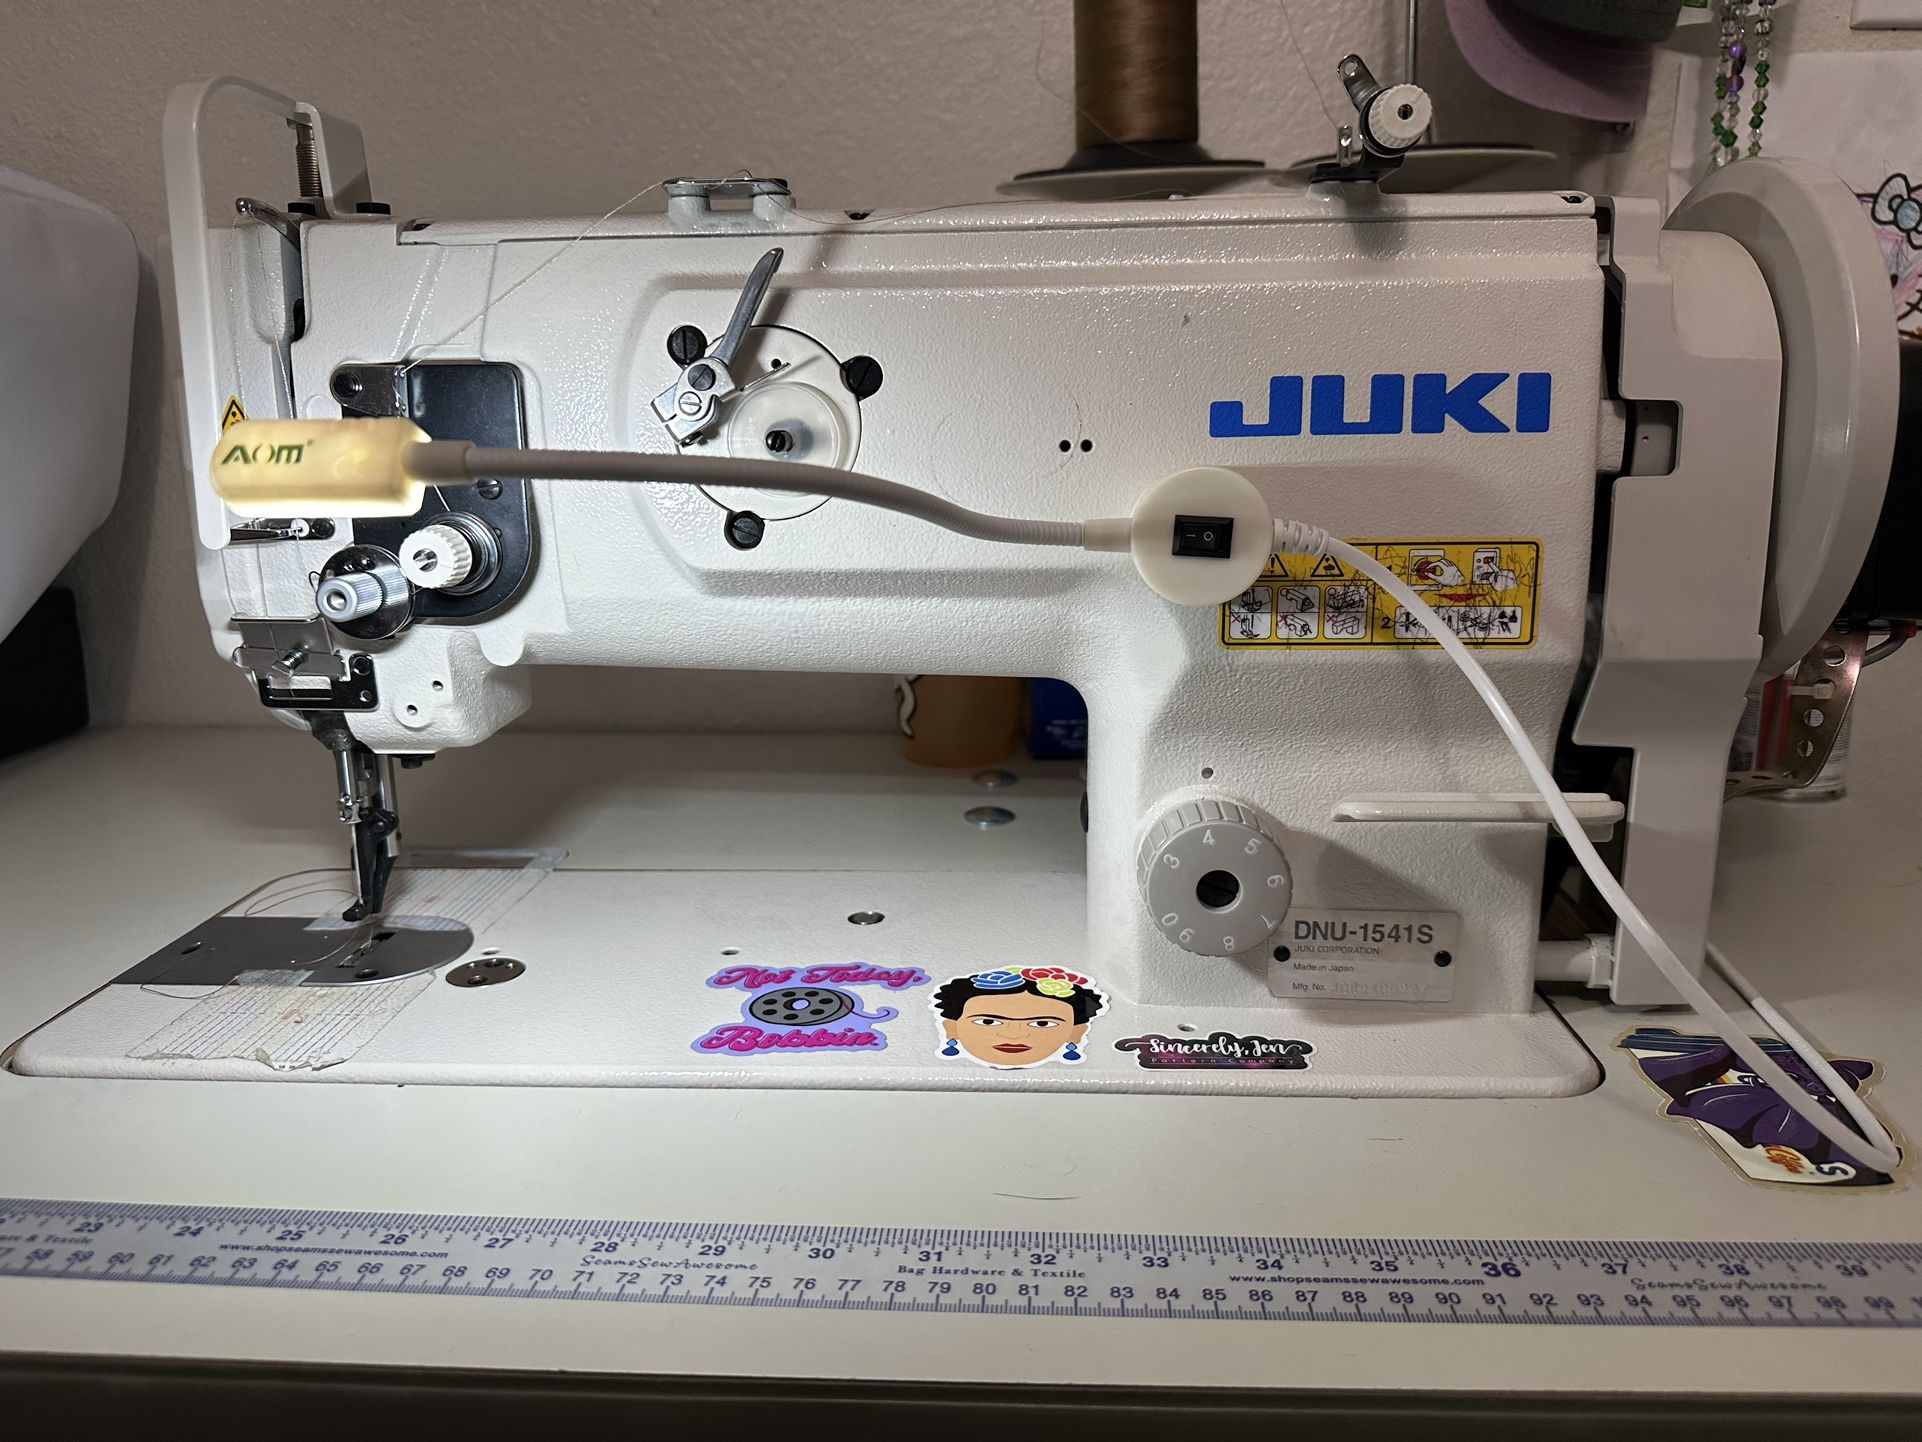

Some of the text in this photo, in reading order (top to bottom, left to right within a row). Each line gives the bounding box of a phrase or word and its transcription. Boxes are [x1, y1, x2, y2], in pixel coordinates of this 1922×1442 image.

[1209, 372, 1552, 438] JUKI
[1202, 829, 1215, 846] 4
[1244, 838, 1262, 854] 5
[1163, 853, 1180, 869] 3
[1161, 912, 1179, 926] 0
[1294, 920, 1433, 944] DNU-1541S
[1222, 936, 1235, 952] 8
[1294, 945, 1381, 955] JUKI CORPORATION
[1293, 963, 1354, 973] Made in Japan
[713, 967, 796, 989] Not
[1312, 983, 1326, 992] No.
[1250, 1039, 1300, 1057] Jen
[73, 1222, 103, 1233] 23
[174, 1226, 204, 1236] 24
[276, 1229, 306, 1241] 25
[379, 1234, 409, 1245] 26
[483, 1237, 514, 1249] 27
[590, 1241, 619, 1253] 28
[698, 1244, 727, 1256] 29
[808, 1248, 836, 1259] 30
[918, 1250, 944, 1262] 31
[1029, 1253, 1057, 1266] 32
[1142, 1256, 1170, 1268] 33
[1255, 1258, 1284, 1271] 34
[1369, 1260, 1399, 1272] 35
[1481, 1261, 1522, 1278] 36
[1601, 1263, 1629, 1275] 37
[1718, 1263, 1750, 1276] 38
[1836, 1264, 1868, 1277] 39
[897, 1265, 1086, 1278] Bag Hardware & Textile
[108, 1253, 135, 1264] 60
[149, 1254, 175, 1266] 61
[190, 1256, 217, 1268] 62
[231, 1257, 258, 1269] 63
[273, 1259, 300, 1271] 64
[314, 1260, 342, 1273] 65
[357, 1262, 384, 1274] 66
[399, 1264, 427, 1276] 67
[442, 1265, 468, 1278] 68
[485, 1267, 511, 1279] 69
[528, 1268, 554, 1281] 70
[571, 1270, 596, 1282] 71
[615, 1272, 640, 1284] 72
[659, 1273, 684, 1286] 73
[703, 1275, 728, 1287] 74
[748, 1276, 773, 1289] 75
[792, 1278, 817, 1290] 76
[837, 1279, 862, 1291] 77
[882, 1280, 907, 1293] 78
[928, 1281, 952, 1294] 79
[972, 1282, 997, 1295] 80
[1018, 1284, 1040, 1296] 81
[1063, 1285, 1088, 1297] 82
[1110, 1286, 1135, 1299] 83
[1156, 1287, 1181, 1300] 84
[1202, 1288, 1227, 1301] 85
[1248, 1289, 1274, 1302] 86
[1294, 1290, 1319, 1303] 87
[1341, 1291, 1368, 1303] 88
[1388, 1291, 1414, 1304] 89
[1435, 1292, 1462, 1304] 90
[1482, 1293, 1507, 1306] 91
[1577, 1294, 1605, 1306] 93
[1624, 1294, 1653, 1307] 94
[1229, 1274, 1485, 1286] www.shopseamssewawesome.com
